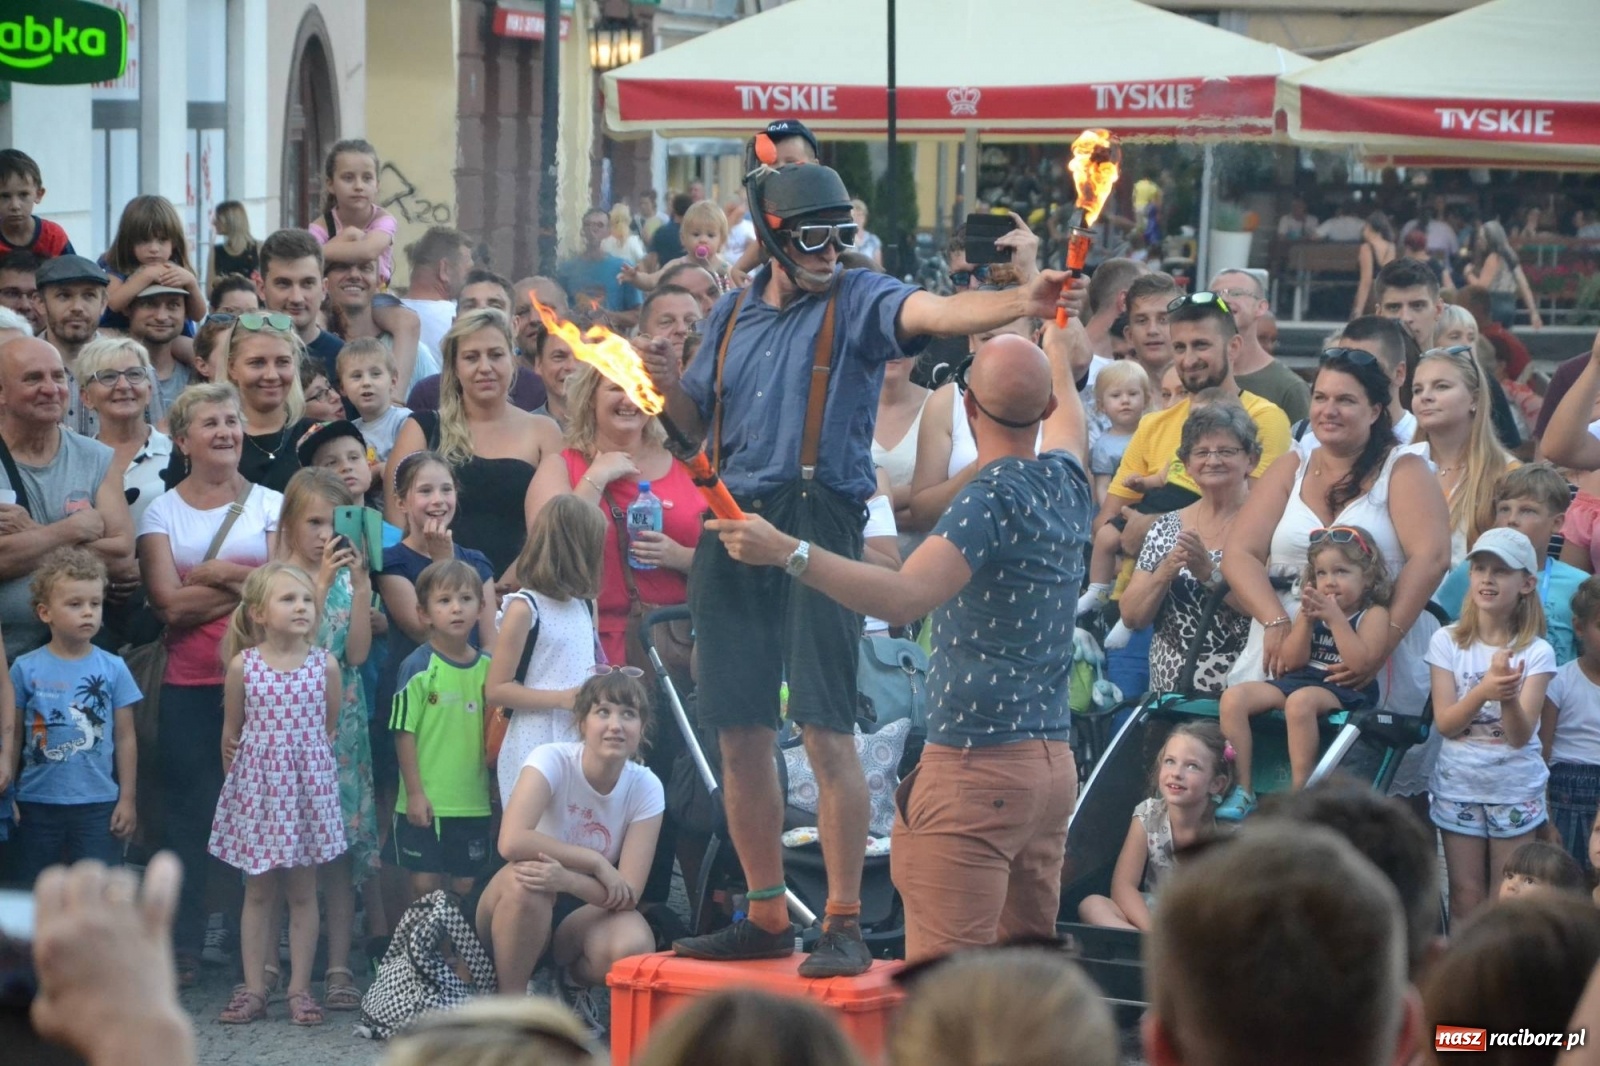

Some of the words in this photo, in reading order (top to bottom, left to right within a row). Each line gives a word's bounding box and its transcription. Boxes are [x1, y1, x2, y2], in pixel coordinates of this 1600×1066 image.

[0, 15, 106, 56] abka
[734, 85, 838, 111] TYSKIE
[1090, 83, 1195, 111] TYSKIE
[1434, 107, 1555, 136] TYSKIE
